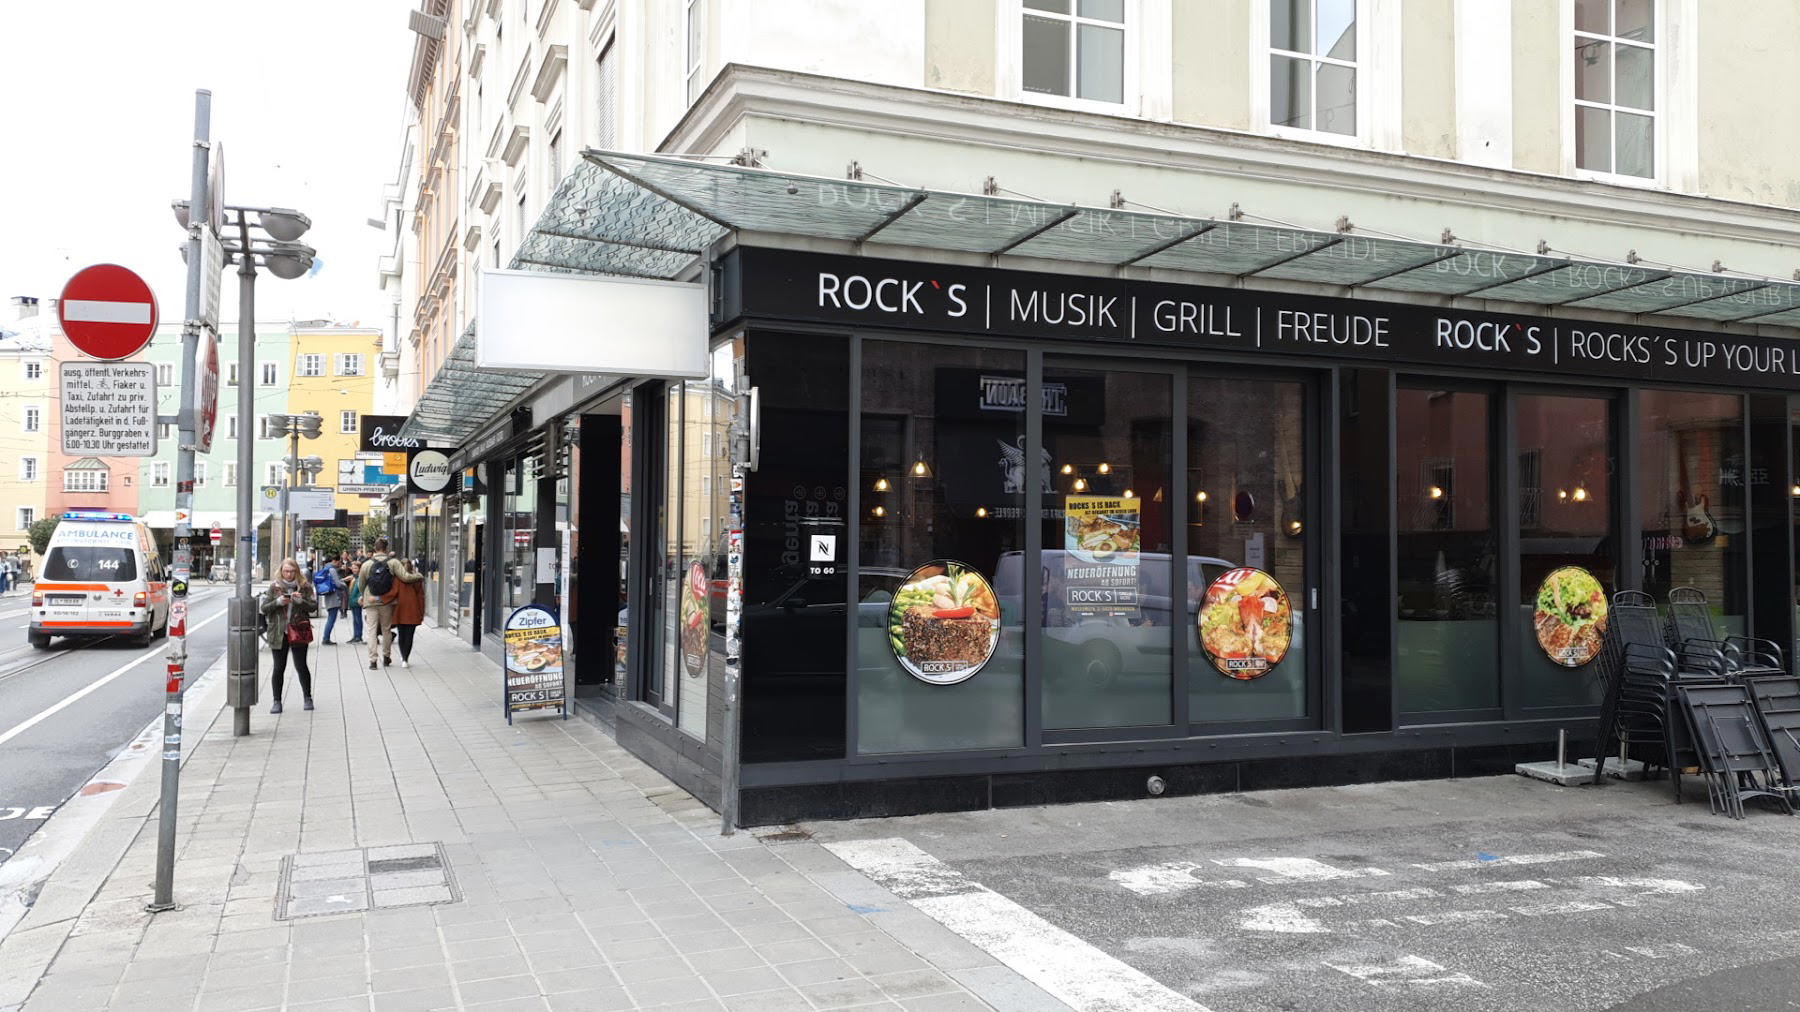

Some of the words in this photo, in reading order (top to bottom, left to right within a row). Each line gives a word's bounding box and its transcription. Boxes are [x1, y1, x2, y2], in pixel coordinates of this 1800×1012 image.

[1010, 288, 1118, 329] MUSIK
[1152, 300, 1242, 338] GRILL
[1277, 309, 1390, 348] FREUDE
[1684, 340, 1717, 369] UP
[1721, 343, 1786, 374] YOUR
[113, 379, 137, 390] Fiaker
[87, 391, 115, 402] Zufahrt
[117, 393, 127, 401] zu
[108, 403, 136, 414] Zufahrt
[99, 427, 142, 440] Burggraben
[102, 440, 115, 450] Uhr
[116, 440, 150, 452] gestattet
[414, 461, 450, 477] Ludwig
[58, 529, 134, 541] AMBULANCE
[98, 559, 120, 570] 144
[809, 567, 821, 575] TO
[823, 567, 835, 575] GO
[1067, 565, 1137, 579] NEUERÖFFNUNG
[519, 617, 547, 628] Zipfer
[507, 671, 563, 687] NEUERÖFFNUNG
